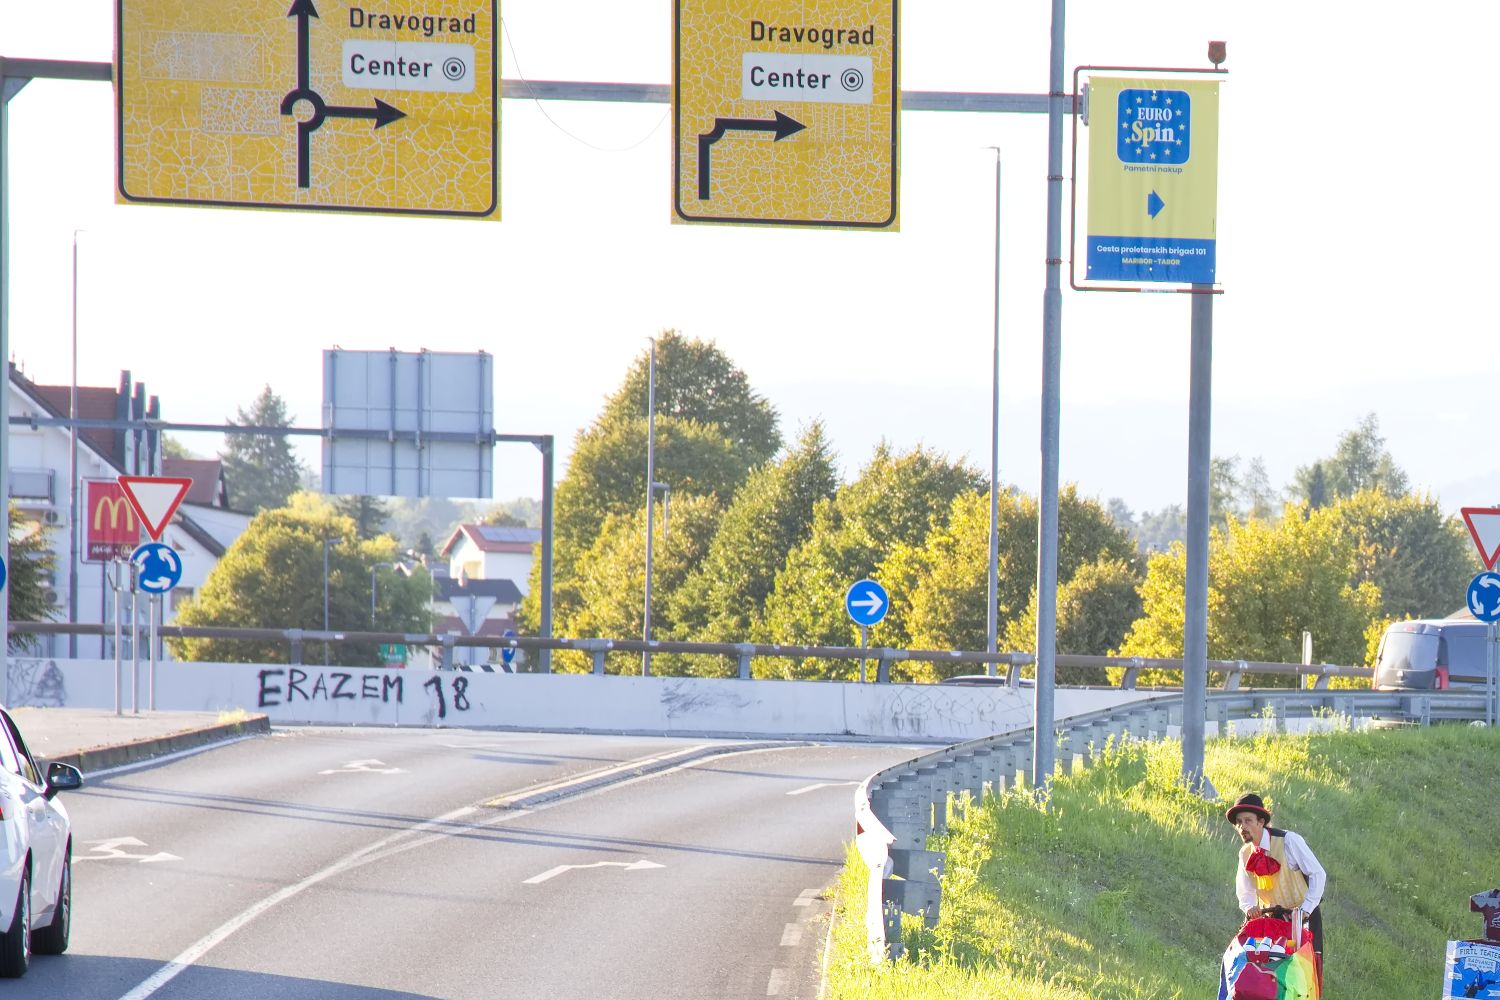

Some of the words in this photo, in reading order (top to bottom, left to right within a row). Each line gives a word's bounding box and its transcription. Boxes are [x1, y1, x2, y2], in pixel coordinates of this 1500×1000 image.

[350, 7, 476, 37] Dravograd
[750, 20, 874, 49] Dravograd
[350, 53, 433, 78] Center
[750, 66, 831, 89] Center
[1137, 107, 1173, 121] EURO
[1131, 120, 1175, 147] Spin
[1124, 165, 1156, 173] Pametni
[1158, 166, 1183, 175] nakup
[1097, 245, 1120, 253] Cesta
[1121, 245, 1168, 255] proletarskih
[1169, 246, 1195, 256] brigad
[1122, 257, 1153, 265] MARIBOR
[258, 668, 404, 708] ERAZEM
[424, 675, 470, 719] 18
